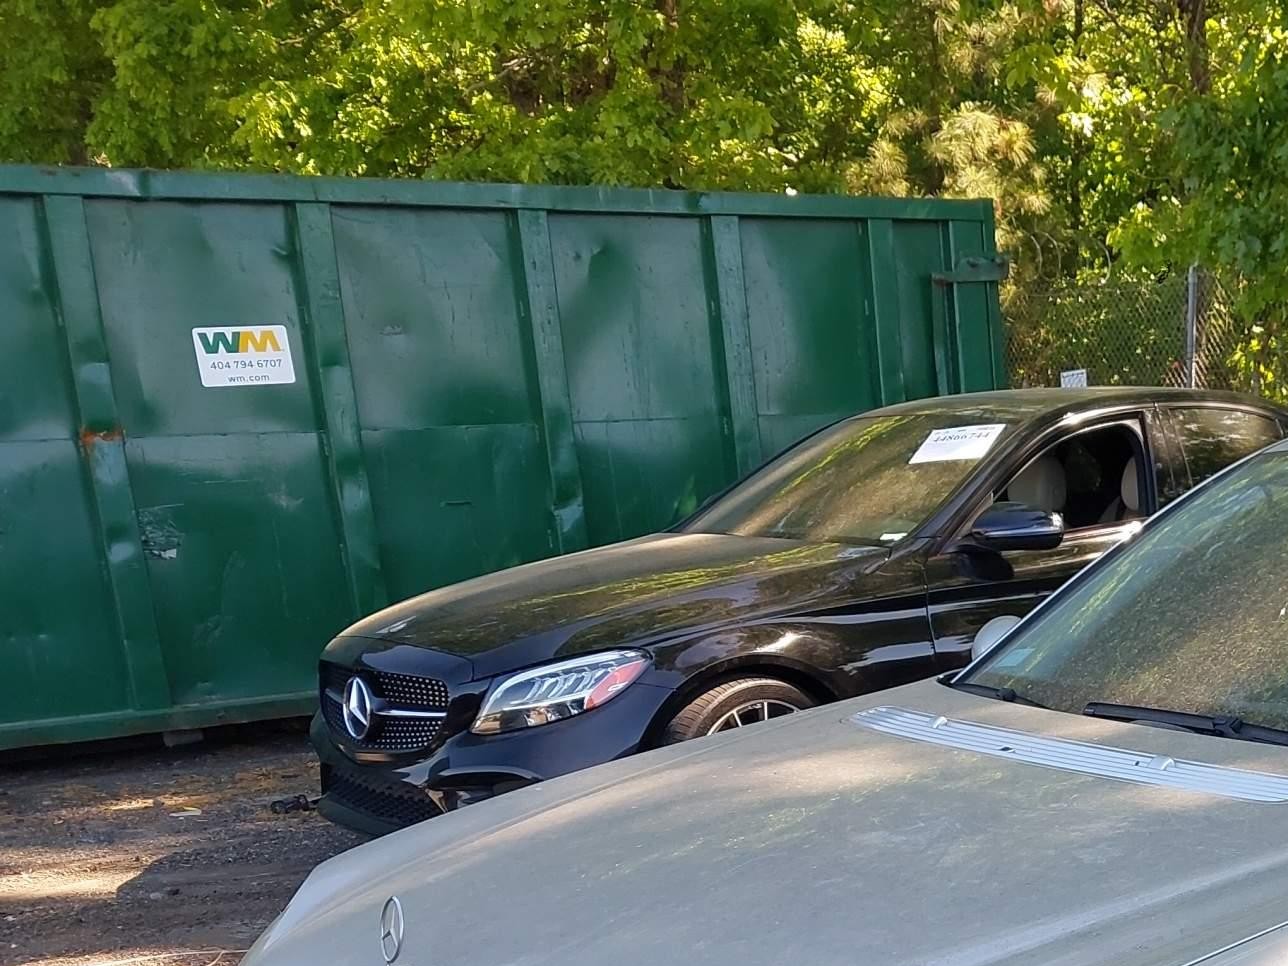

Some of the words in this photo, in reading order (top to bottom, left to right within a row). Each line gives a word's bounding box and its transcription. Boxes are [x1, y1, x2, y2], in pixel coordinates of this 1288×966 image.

[197, 329, 282, 355] WM
[210, 361, 231, 370] 404
[233, 360, 254, 369] 794
[256, 359, 282, 369] 6707
[228, 374, 270, 383] wm.com
